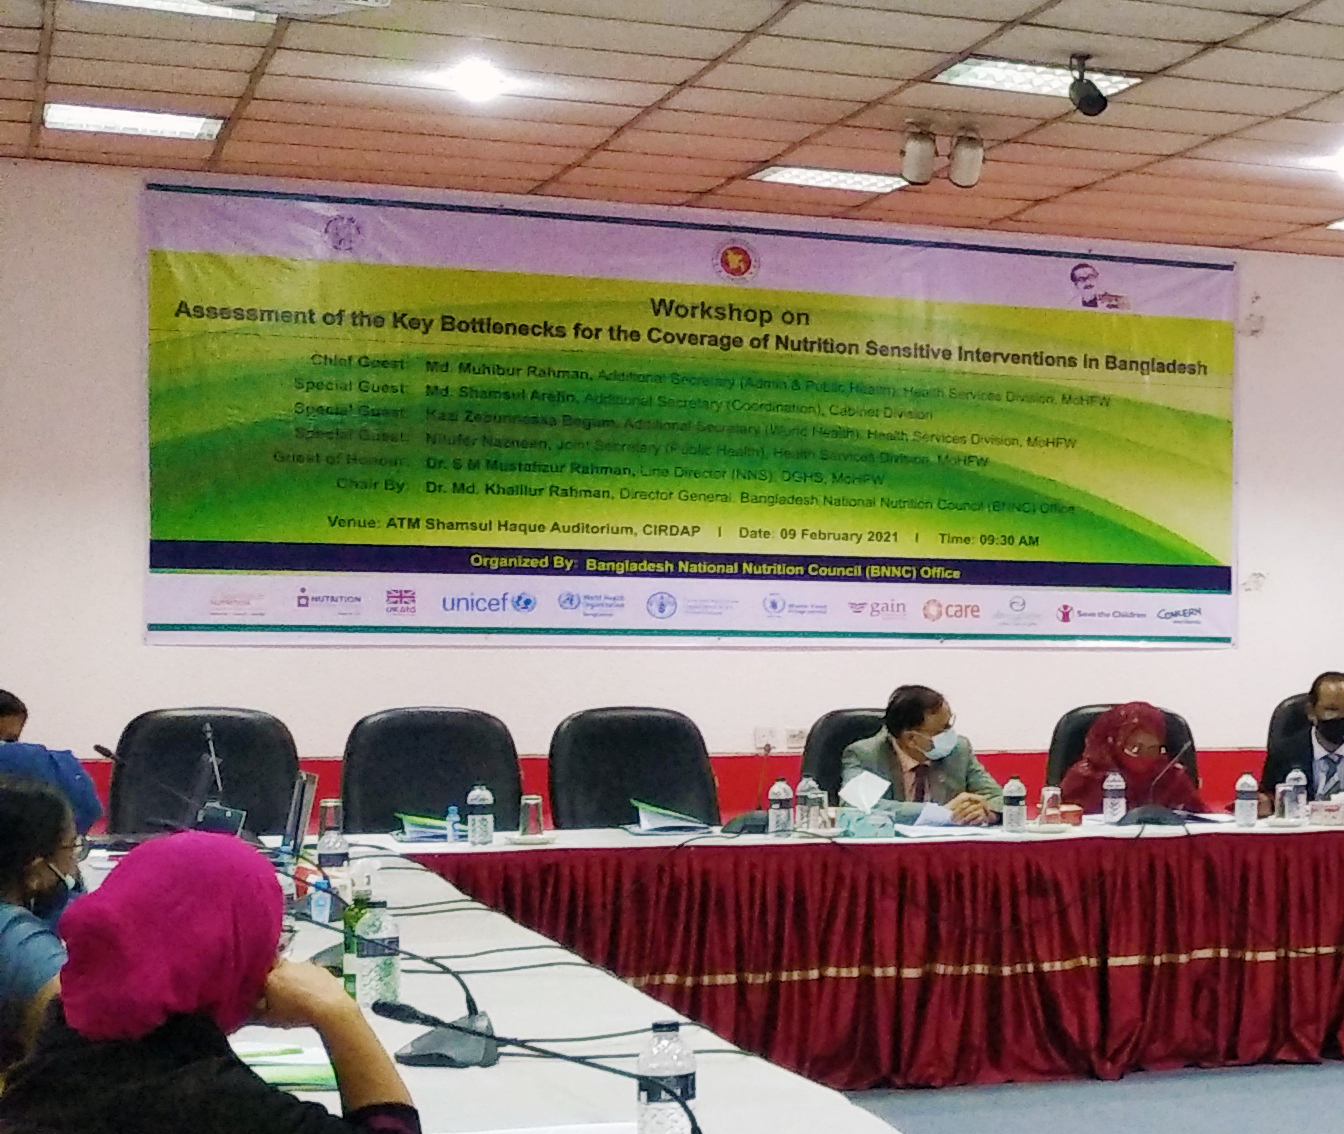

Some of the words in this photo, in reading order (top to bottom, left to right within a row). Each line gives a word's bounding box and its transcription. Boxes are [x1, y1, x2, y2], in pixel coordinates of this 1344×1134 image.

[651, 297, 773, 327] Workshop
[781, 310, 810, 326] on
[175, 300, 316, 324] Assessment
[322, 308, 345, 326] of
[351, 310, 385, 328] the
[393, 311, 434, 335] Key
[441, 315, 567, 338] Bottlenecks
[573, 322, 603, 340] for
[609, 325, 640, 342] the
[647, 327, 744, 351] Coverage
[749, 333, 770, 350] of
[775, 334, 859, 355] Nutrition
[865, 340, 952, 361] Sensitive
[958, 346, 1078, 368] Interventions
[1105, 354, 1208, 377] Bangladesh
[458, 361, 522, 376] Muhibur
[527, 365, 594, 381] Rahman,
[949, 387, 1000, 402] Services
[294, 376, 352, 392] Special
[459, 386, 526, 400] Shamsul
[884, 406, 933, 420] Division
[914, 430, 967, 445] Services
[970, 433, 1022, 448] Division,
[1027, 436, 1077, 449] MoHFW
[425, 457, 448, 470] Dr.
[452, 458, 463, 470] S
[467, 459, 481, 471] M
[570, 462, 636, 478] Rahman,
[425, 481, 447, 494] Dr.
[452, 482, 479, 495] Md.
[549, 485, 616, 501] Rahman,
[619, 487, 674, 501] Director
[740, 491, 819, 507] Bangladesh
[823, 495, 876, 508] National
[880, 497, 933, 510] Nutrition
[327, 515, 382, 530] Venue:
[386, 517, 421, 530] ATM
[425, 517, 492, 532] Shamsul
[497, 519, 547, 536] Haque
[550, 521, 638, 538] Auditorium,
[641, 524, 701, 538] CIRDAP
[739, 526, 776, 541] Date:
[780, 527, 797, 541] 09
[801, 528, 863, 545] February
[867, 530, 898, 544] 2021
[938, 532, 975, 546] Time:
[979, 534, 1015, 547] 09:30
[1018, 535, 1040, 547] AM
[470, 553, 549, 571] Organized
[553, 555, 578, 571] By:
[586, 558, 674, 574] Bangladesh
[678, 559, 738, 575] National
[742, 561, 804, 577] Nutrition
[807, 563, 861, 578] Council
[865, 564, 916, 580] (BNNC)
[919, 566, 961, 580] Office
[311, 595, 362, 603] NUTRITION
[442, 592, 508, 612] unicef
[869, 599, 906, 617] gain
[945, 603, 980, 619] care
[1077, 610, 1096, 618] Save
[1098, 610, 1110, 618] the
[1112, 610, 1147, 619] Children
